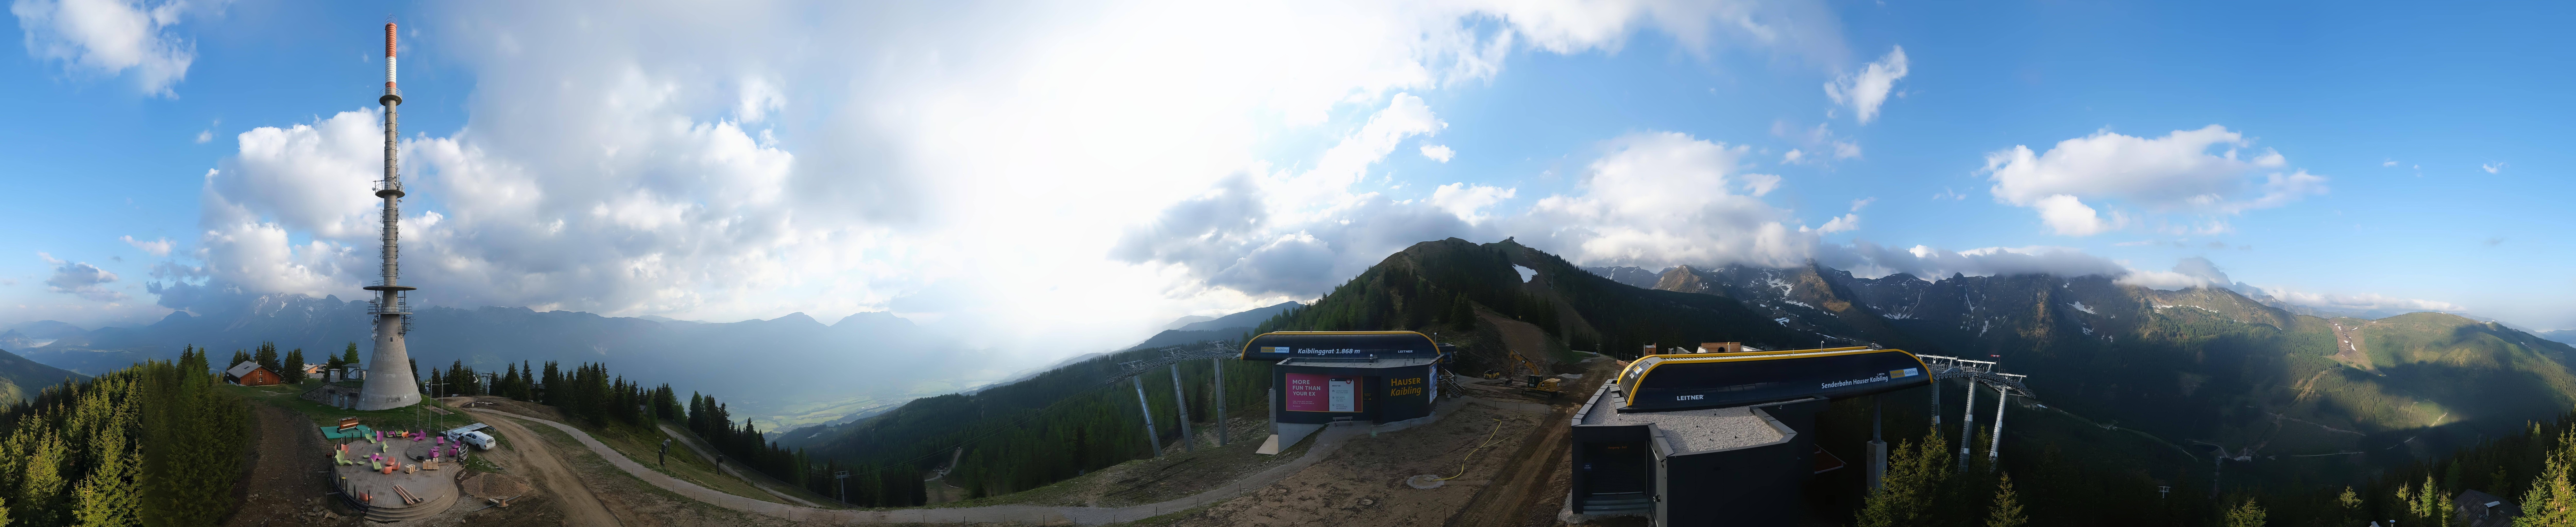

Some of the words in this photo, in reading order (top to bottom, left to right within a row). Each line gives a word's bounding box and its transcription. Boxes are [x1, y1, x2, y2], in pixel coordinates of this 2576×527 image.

[1391, 378, 1421, 386] HAUSER
[1821, 380, 1852, 389] Senderbahn
[1391, 386, 1421, 396] Kaibling
